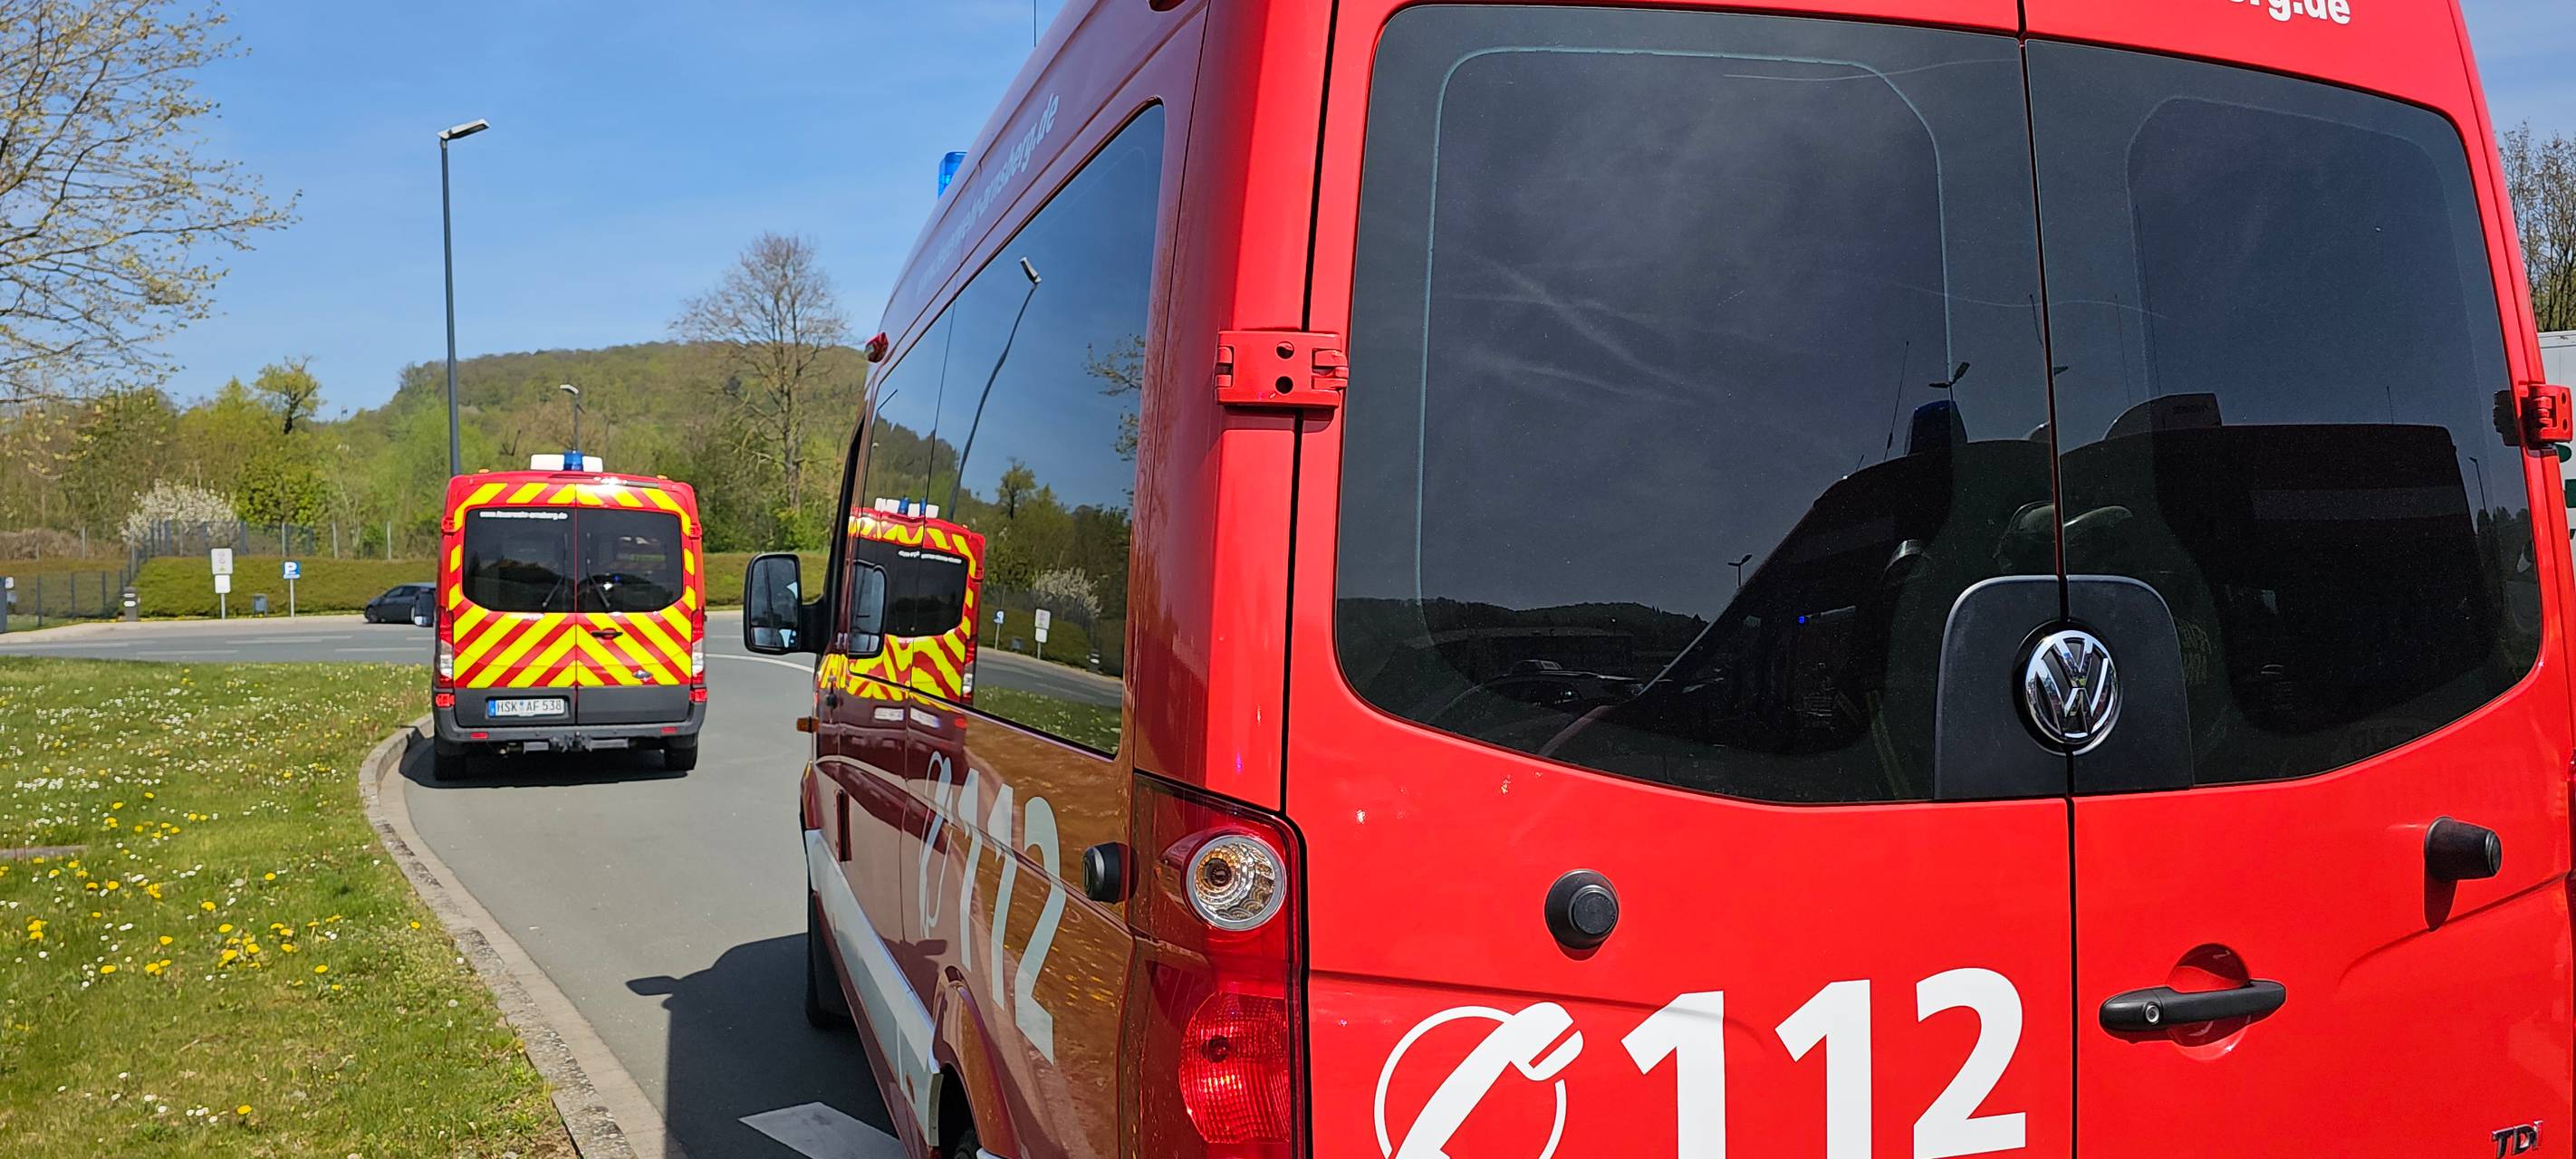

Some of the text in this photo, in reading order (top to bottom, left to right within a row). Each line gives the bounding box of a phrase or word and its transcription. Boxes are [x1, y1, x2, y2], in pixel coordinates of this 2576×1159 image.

[284, 561, 298, 574] P
[497, 699, 562, 713] HSK AF 538
[2029, 632, 2115, 742] VW
[957, 768, 1066, 1065] 112
[1620, 967, 2026, 1159] 112
